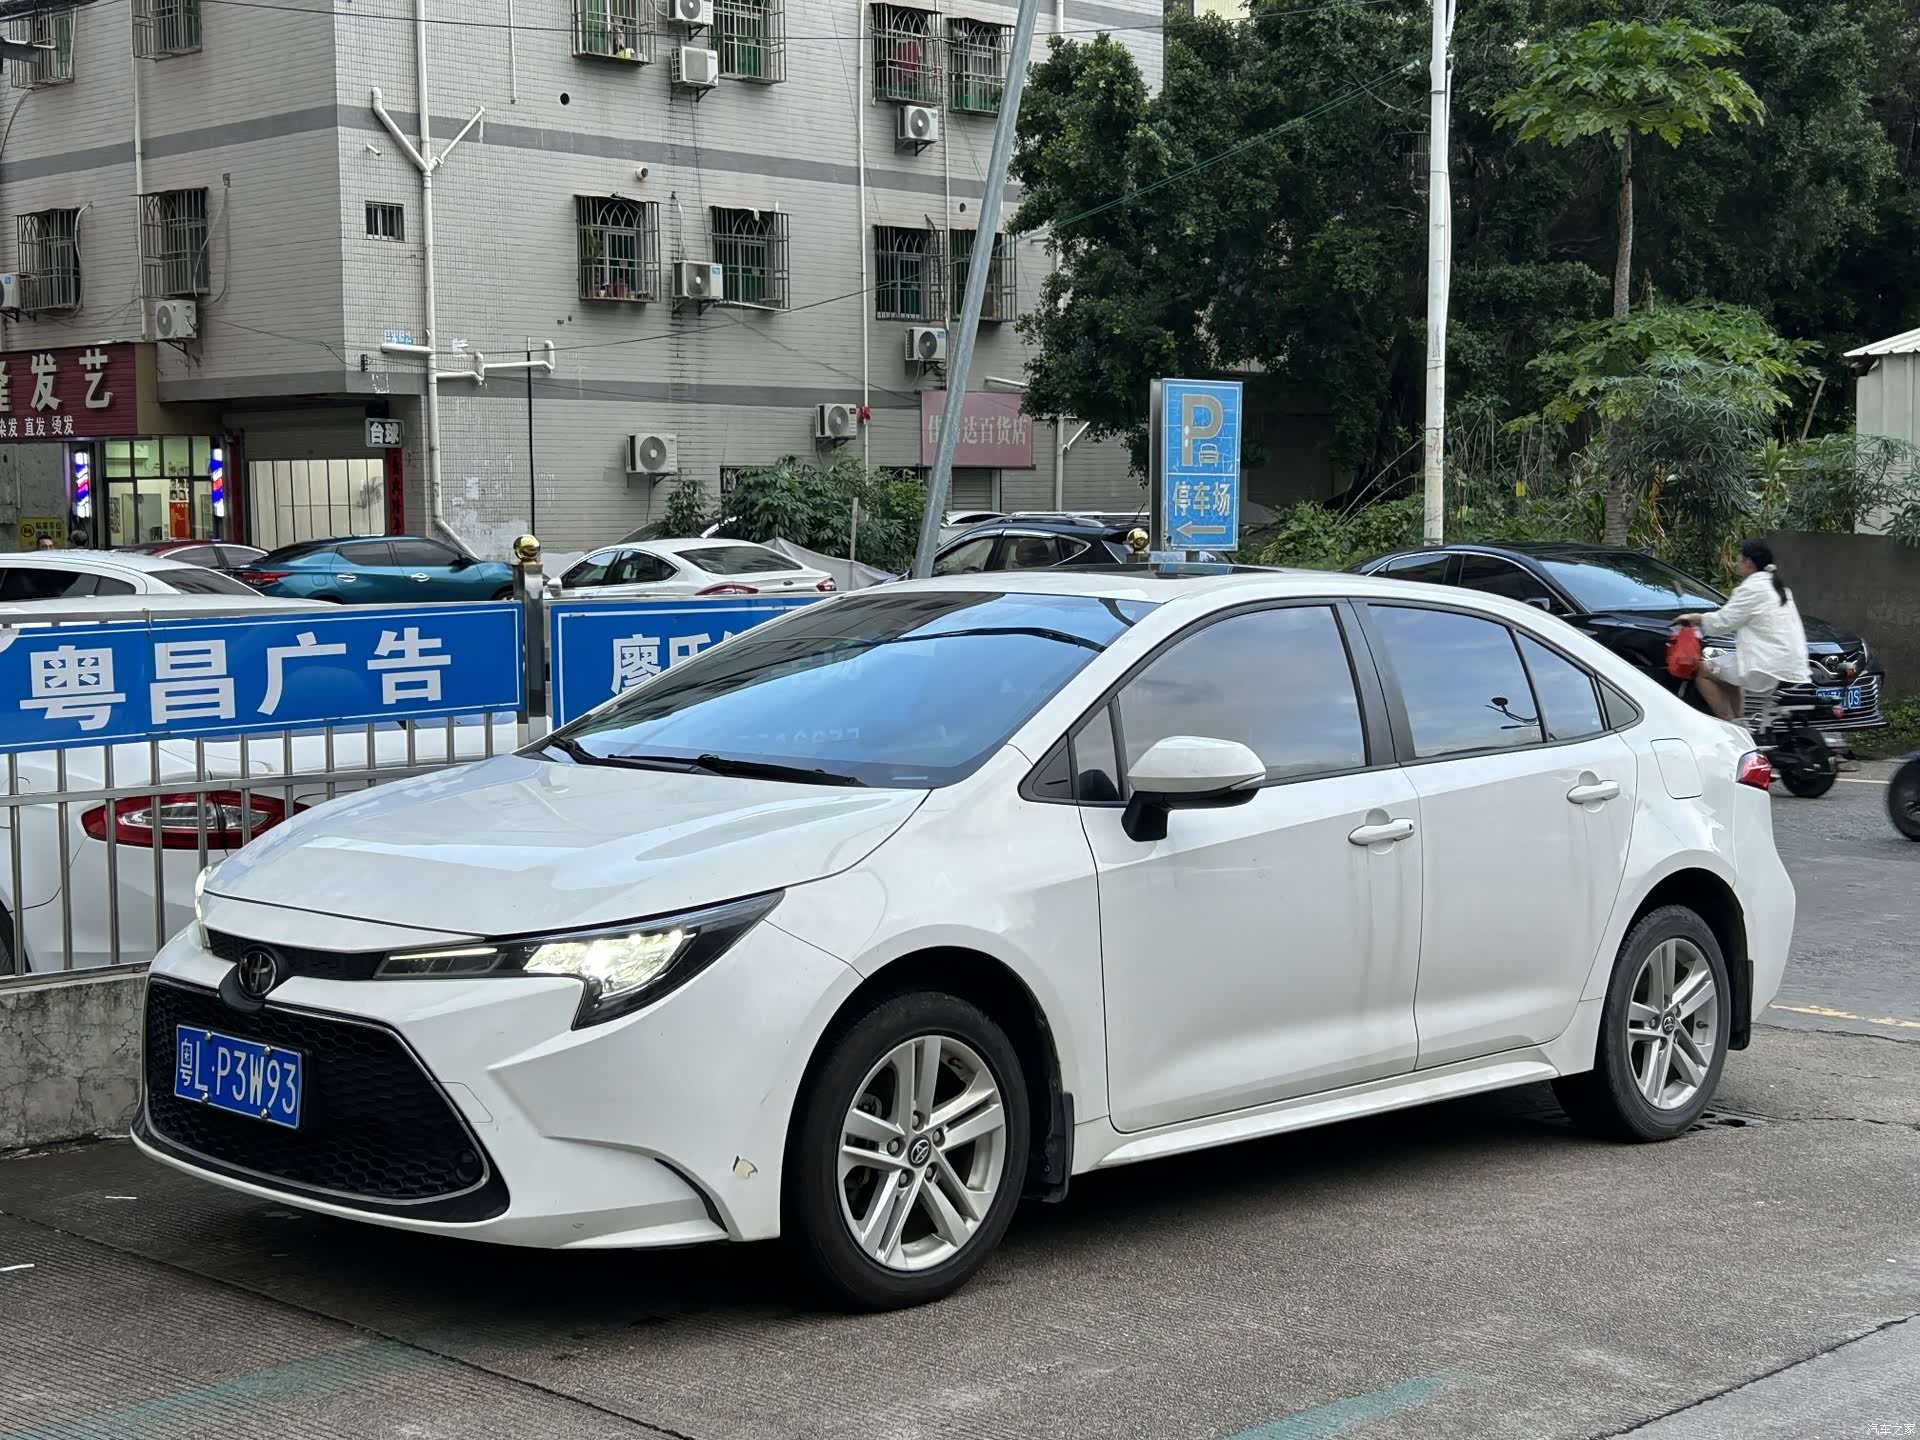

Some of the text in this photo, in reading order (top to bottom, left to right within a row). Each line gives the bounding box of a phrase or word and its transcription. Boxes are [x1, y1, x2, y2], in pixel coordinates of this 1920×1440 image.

[25, 416, 46, 437] 直发
[52, 414, 74, 436] 烫发
[928, 415, 1027, 445] 达百货店
[1181, 393, 1224, 467] P
[1172, 480, 1232, 517] 停车场
[20, 627, 452, 732] 粤昌广告
[611, 631, 734, 695] 廖氏
